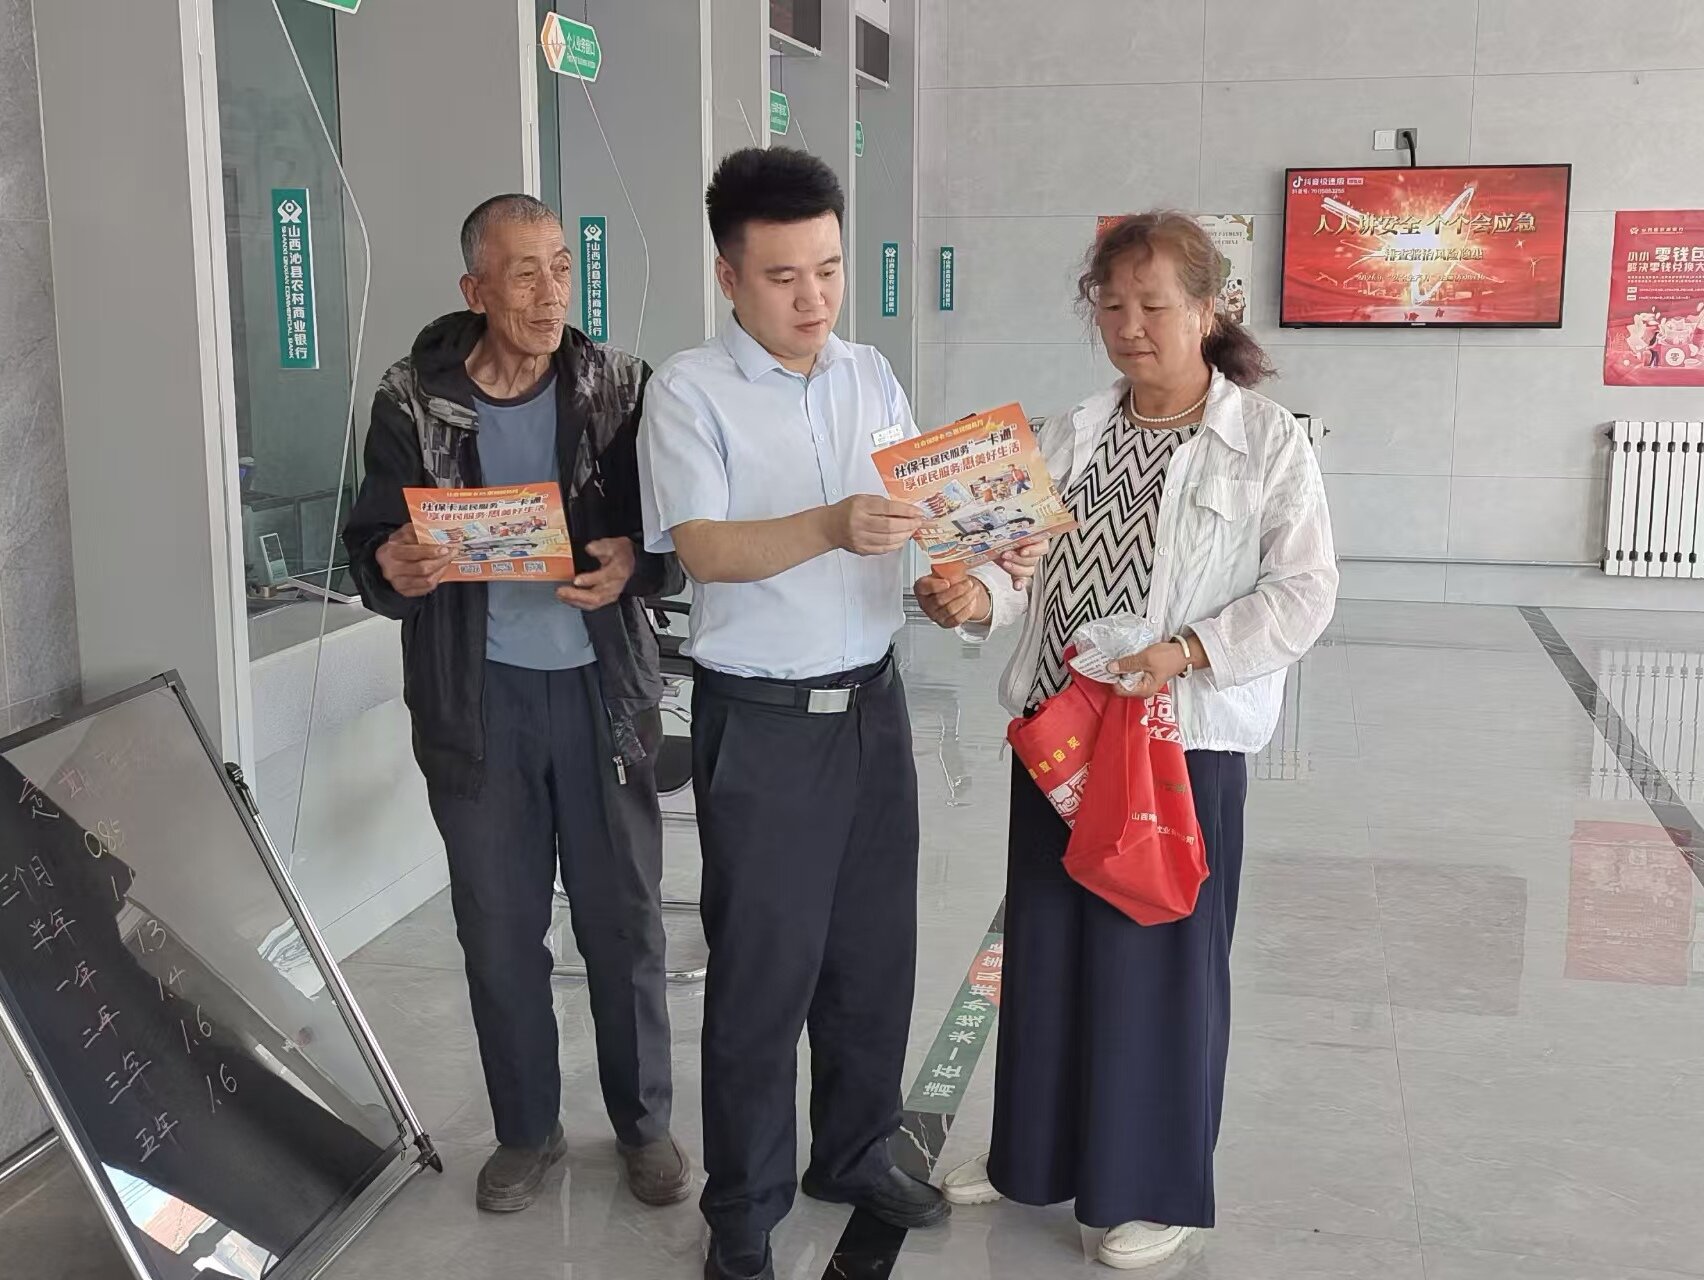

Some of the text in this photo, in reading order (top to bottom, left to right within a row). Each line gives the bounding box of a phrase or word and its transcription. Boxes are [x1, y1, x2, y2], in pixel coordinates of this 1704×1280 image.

[1313, 211, 1536, 236] 人人讲安全 个个会应急
[1627, 246, 1704, 262] 小小 零钱包
[288, 225, 307, 360] 山西沁县农村商业银行
[591, 241, 602, 337] 山西沁县农村商业银行
[1627, 262, 1704, 273] 解决零钱兑换大
[29, 908, 77, 954] 半年
[56, 919, 167, 993] 一年 1.3
[82, 965, 186, 1049] 二年 1.4
[105, 1005, 212, 1104] 三年 1.6
[135, 1063, 238, 1162] 五年 1.6
